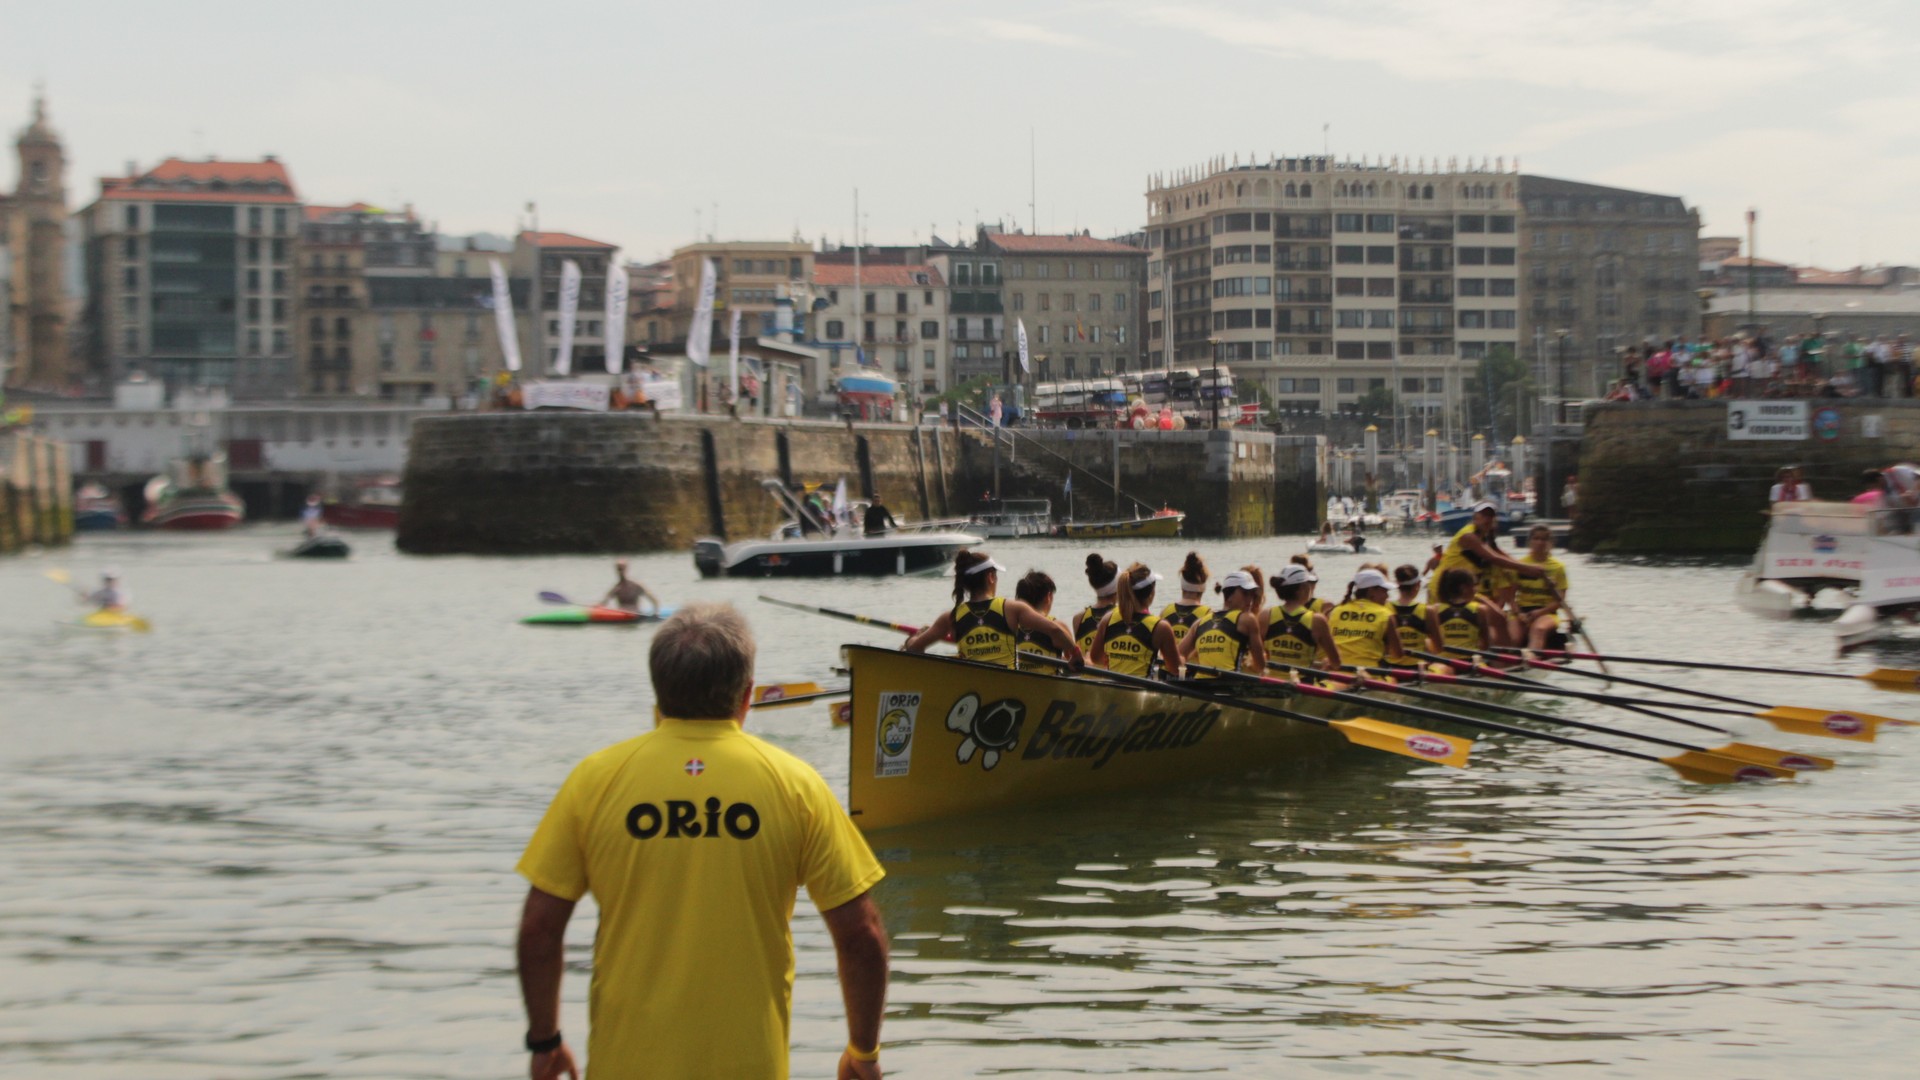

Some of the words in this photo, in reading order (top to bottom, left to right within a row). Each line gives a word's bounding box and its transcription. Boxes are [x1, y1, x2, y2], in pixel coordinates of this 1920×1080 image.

[1729, 410, 1745, 430] 3
[965, 632, 1000, 645] ORIO
[1199, 634, 1226, 645] ORIO
[1111, 641, 1141, 653] ORIO
[1272, 639, 1303, 651] ORIO
[1021, 700, 1222, 770] Babyauto
